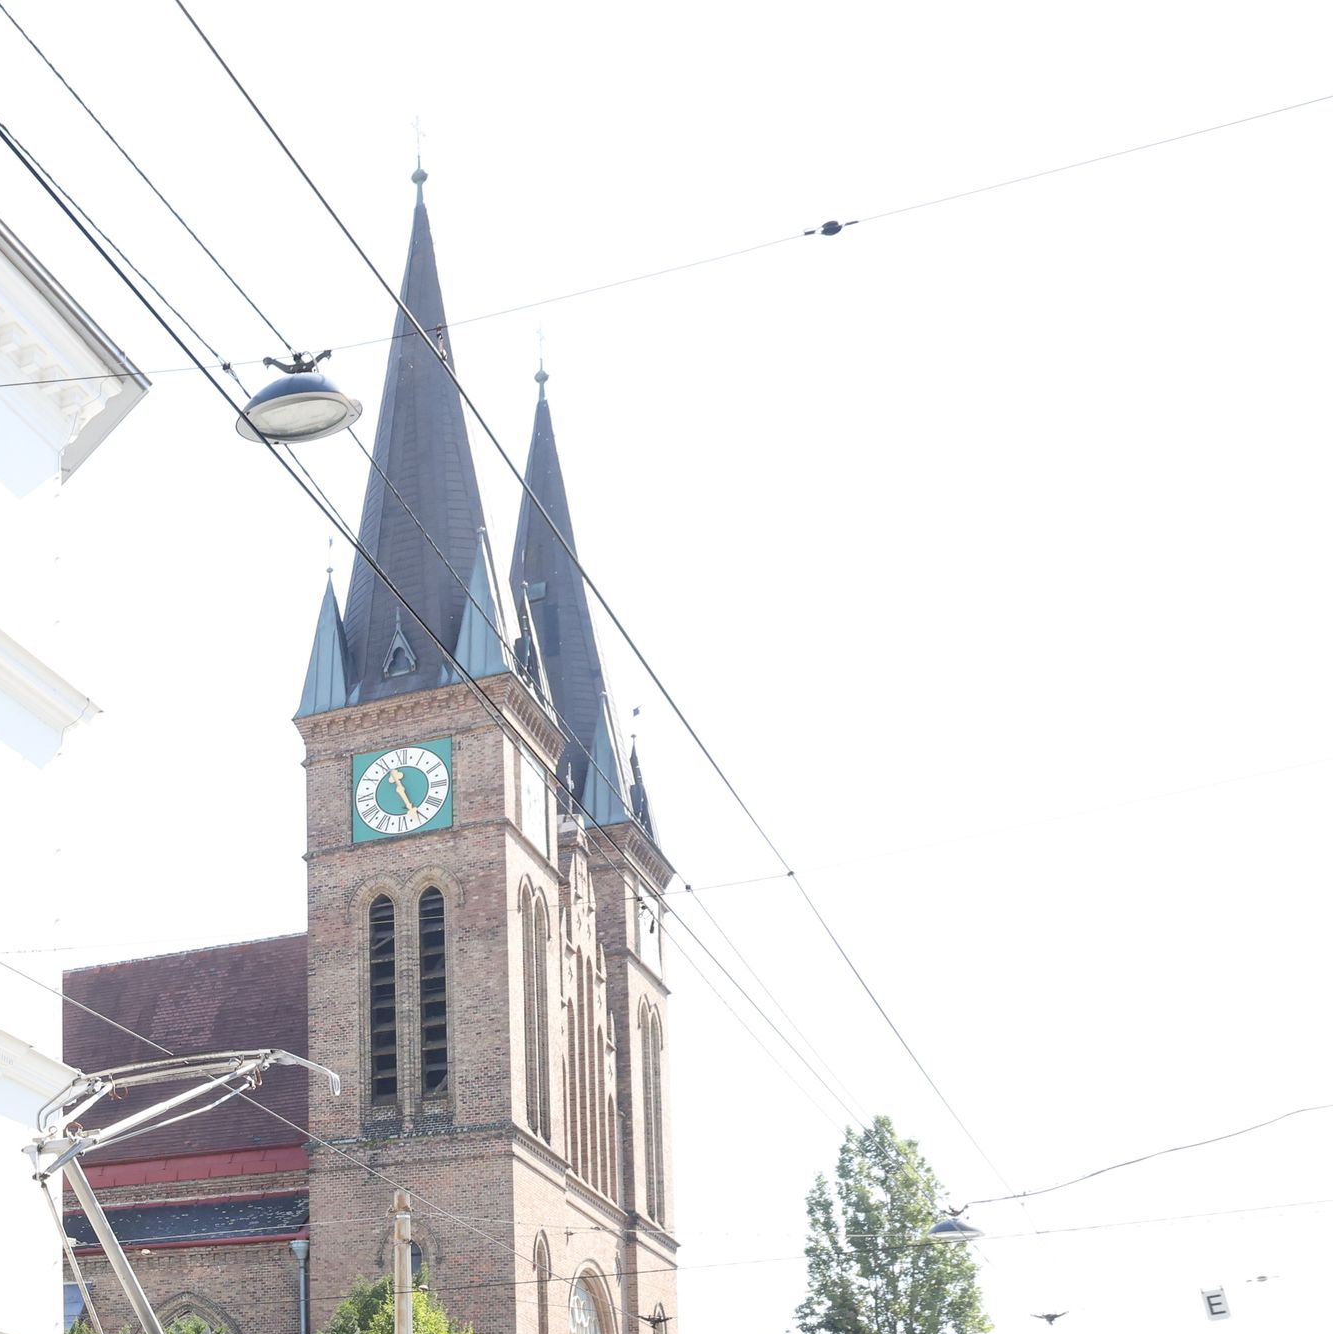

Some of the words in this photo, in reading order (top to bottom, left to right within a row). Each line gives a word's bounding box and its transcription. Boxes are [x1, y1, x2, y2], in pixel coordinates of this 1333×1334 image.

[395, 749, 408, 766] XII
[416, 751, 425, 766] I
[375, 758, 390, 774] XI
[426, 761, 442, 774] II
[430, 778, 447, 788] III
[1206, 1294, 1227, 1316] E
